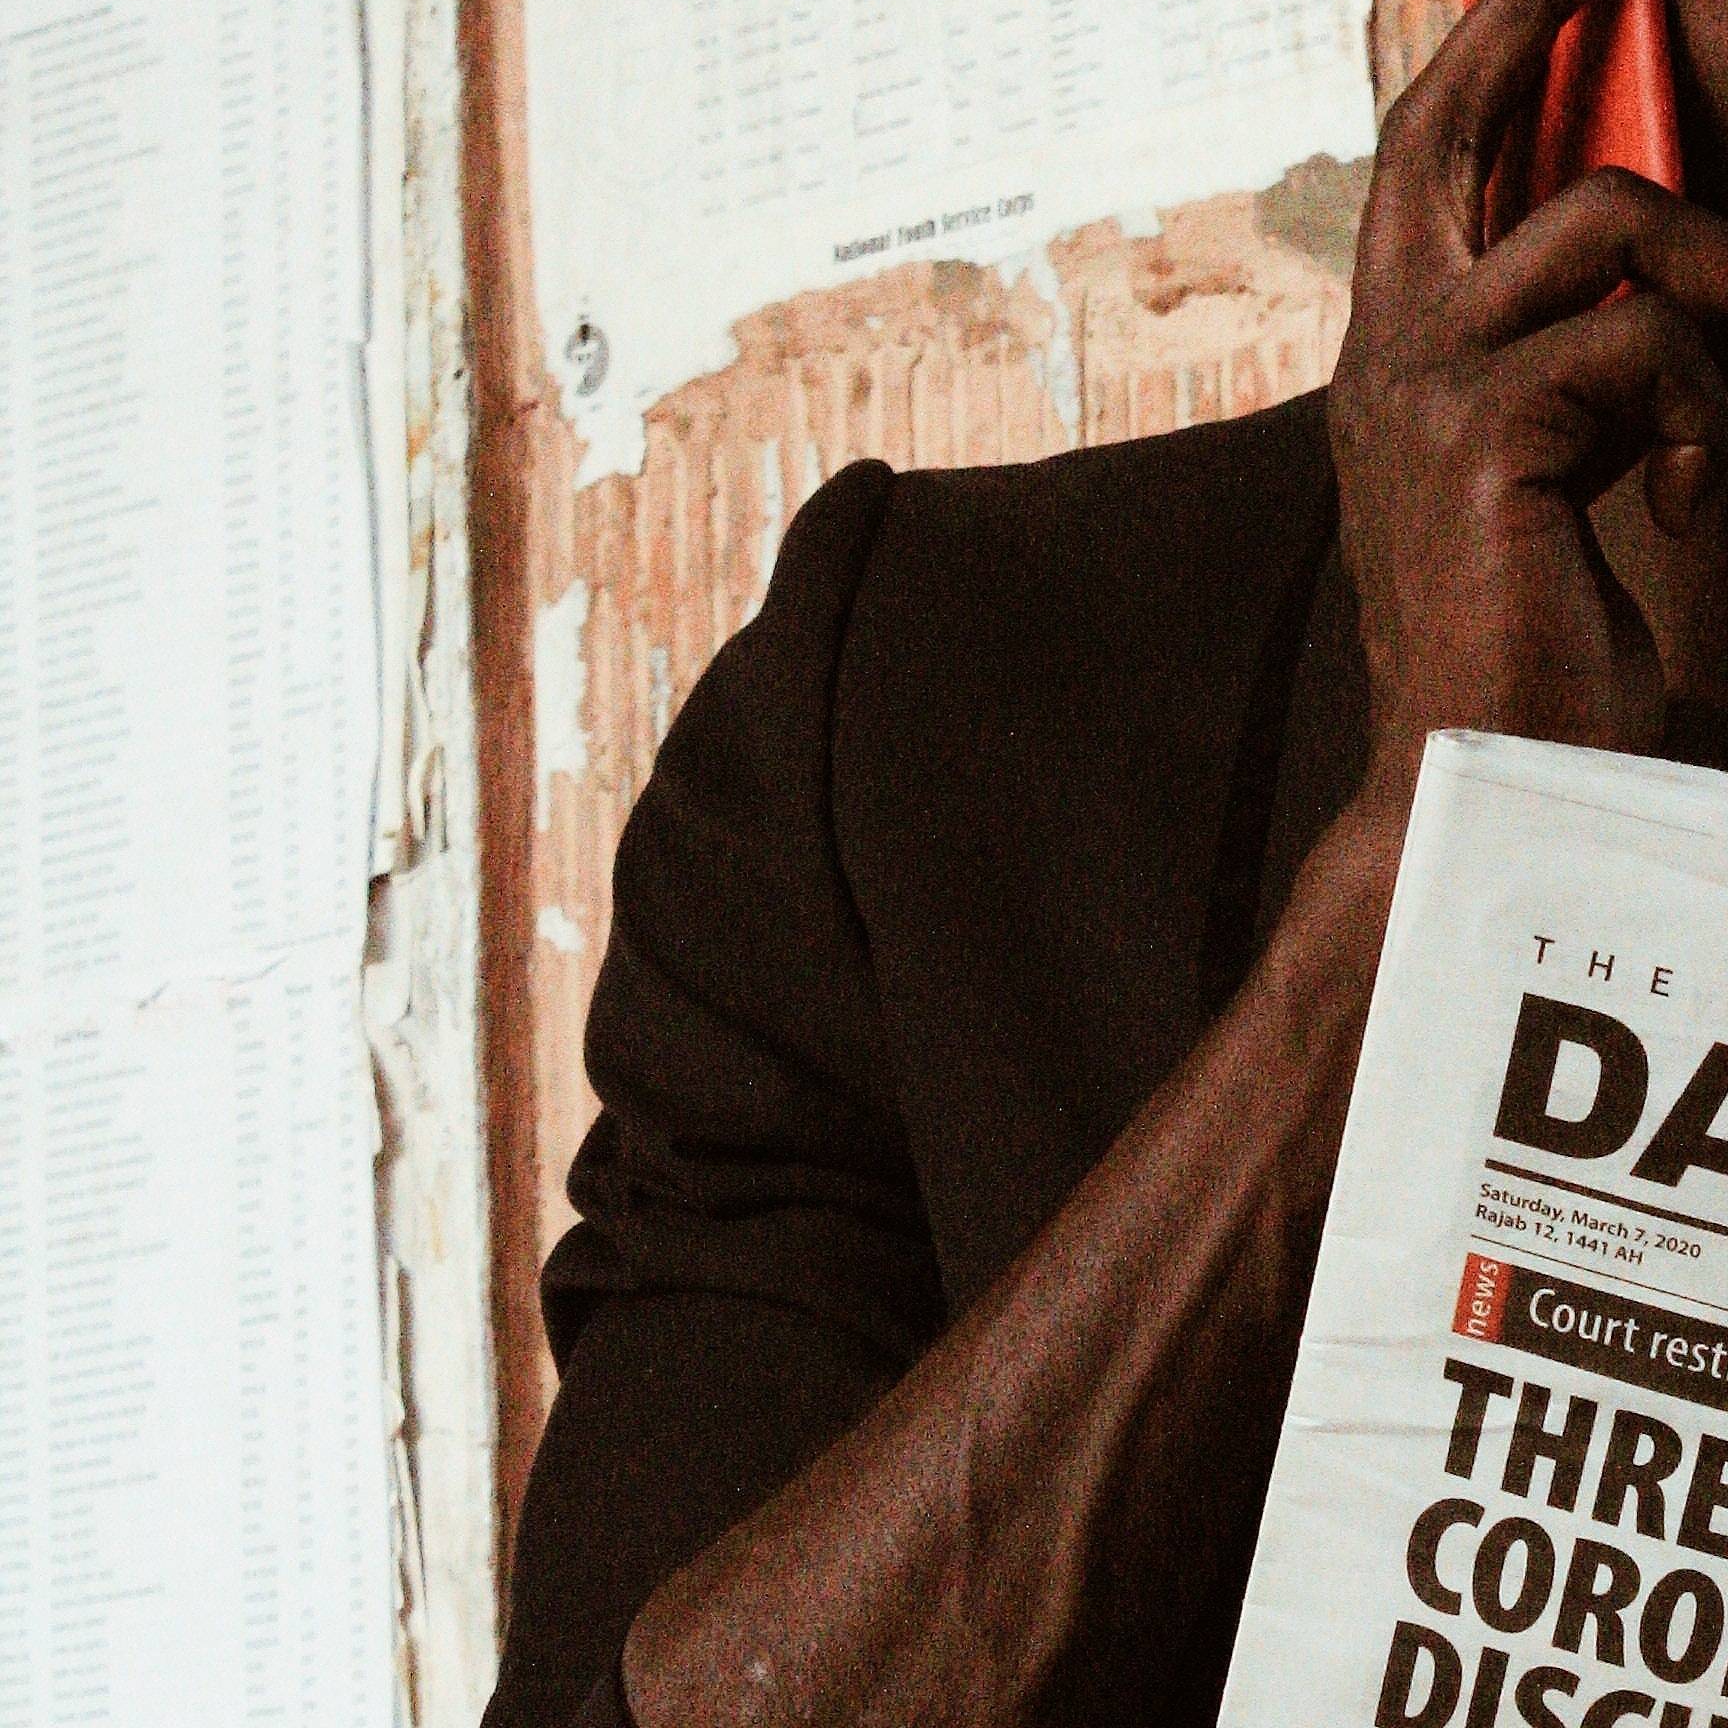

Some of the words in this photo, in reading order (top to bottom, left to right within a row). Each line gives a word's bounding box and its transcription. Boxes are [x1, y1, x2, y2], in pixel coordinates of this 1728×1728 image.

[1533, 935, 1673, 997] THE
[1475, 1203, 1527, 1231] Rajab
[1535, 1222, 1559, 1244] 12,
[1567, 1231, 1609, 1256] 1441
[1614, 1245, 1645, 1265] AH
[1481, 1183, 1565, 1223] Saturday,
[1571, 1209, 1629, 1239] March
[1634, 1227, 1648, 1247] 7,
[1654, 1233, 1702, 1259] 2020
[1466, 1260, 1498, 1336] news
[1529, 1287, 1640, 1361] Court
